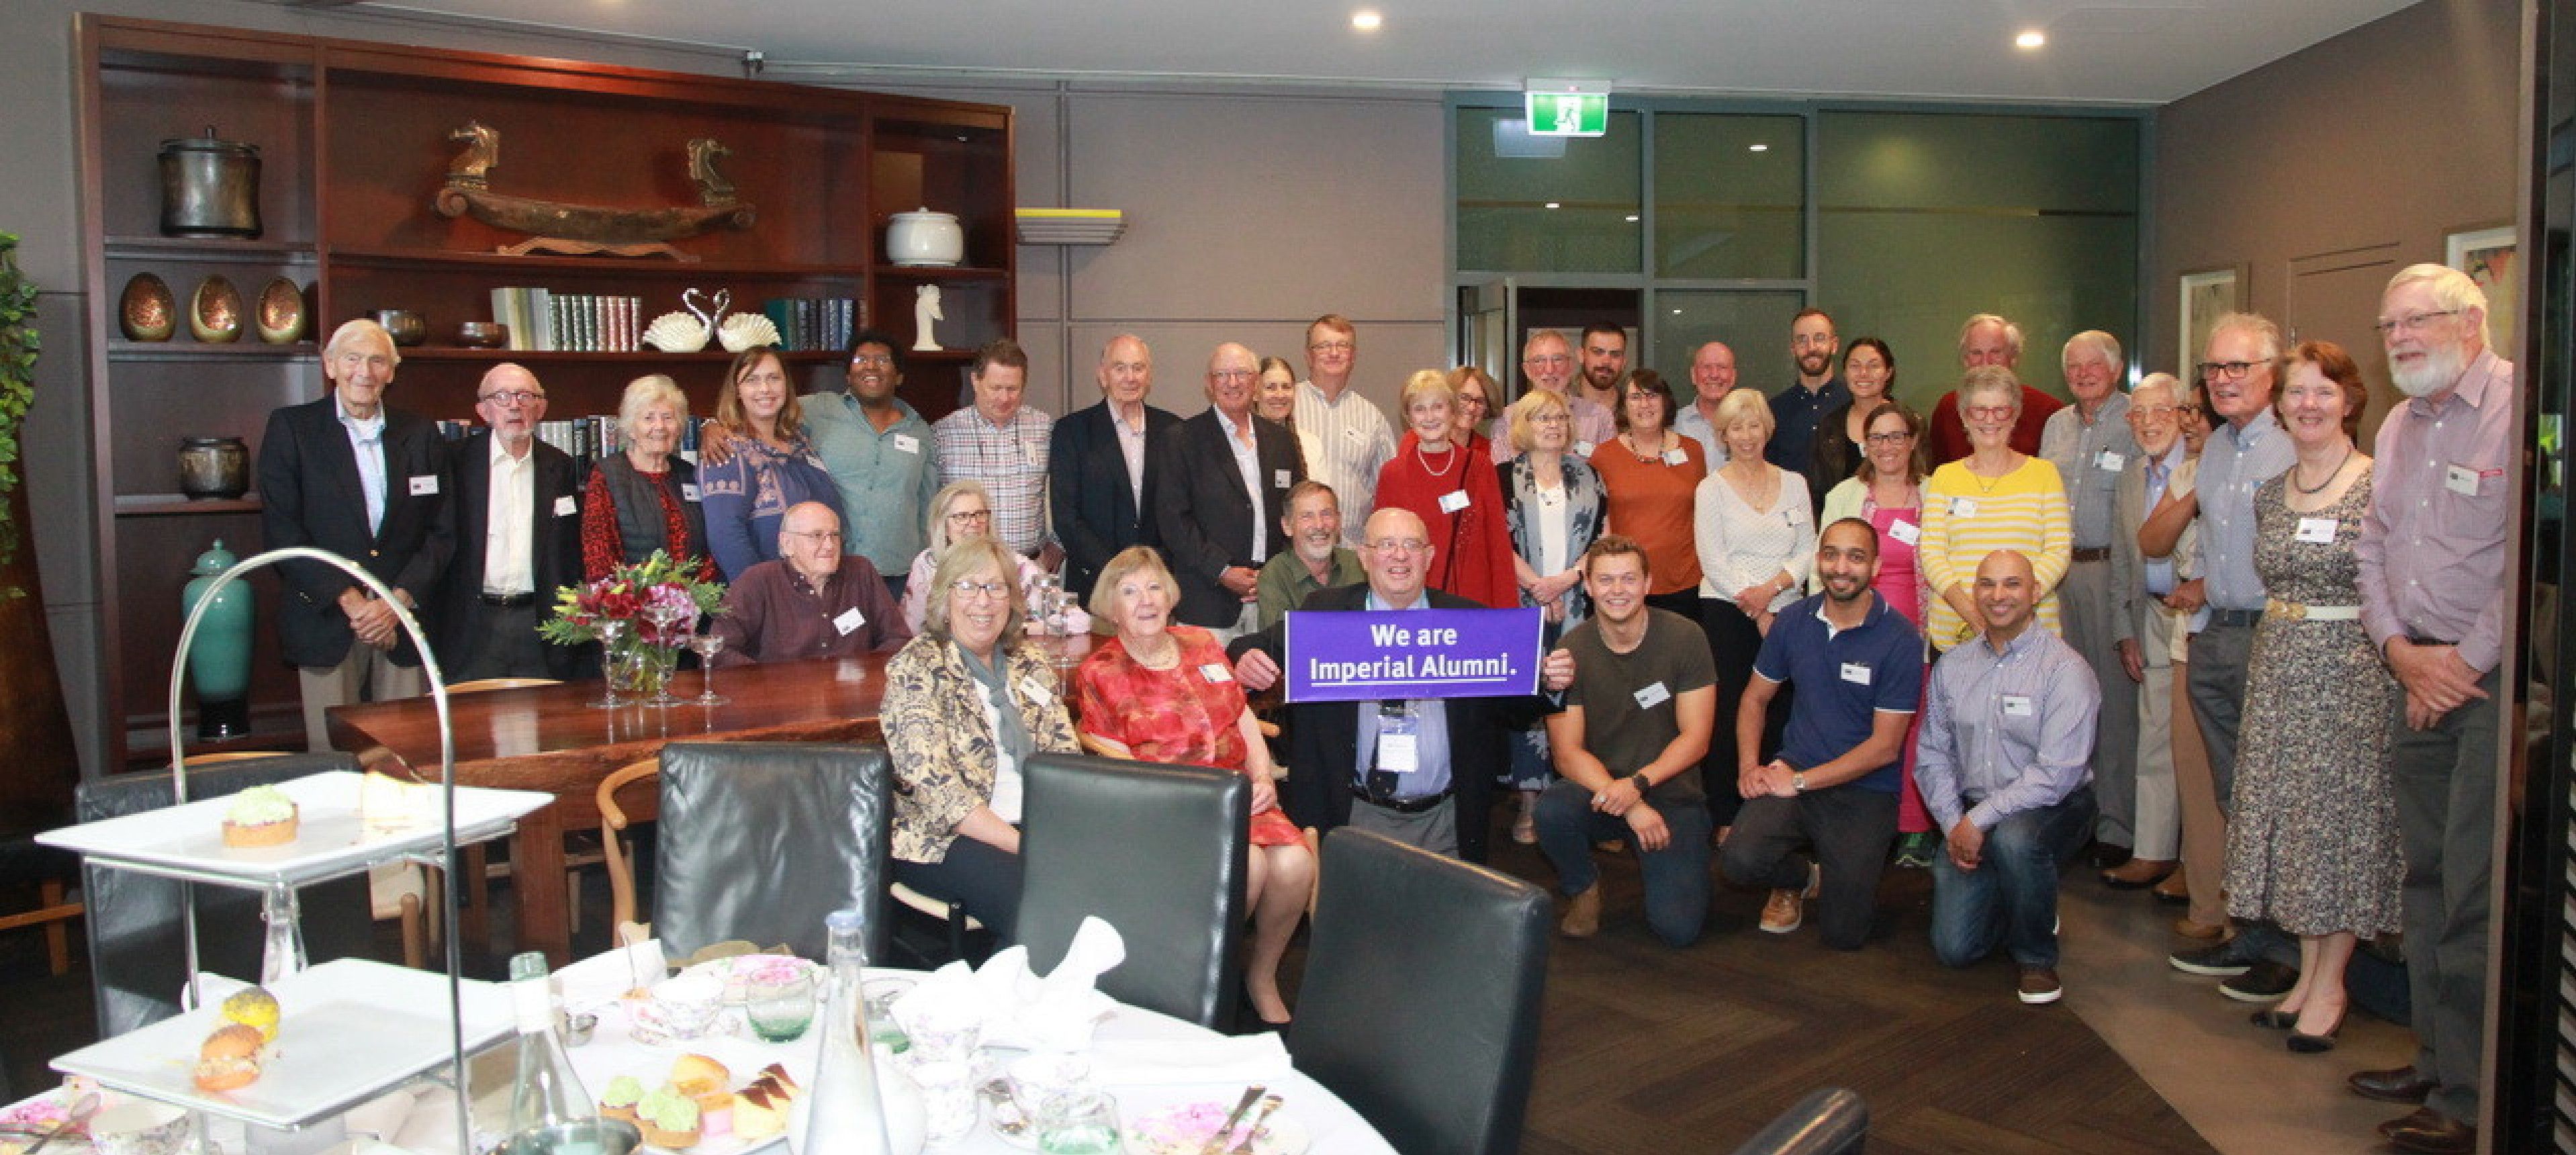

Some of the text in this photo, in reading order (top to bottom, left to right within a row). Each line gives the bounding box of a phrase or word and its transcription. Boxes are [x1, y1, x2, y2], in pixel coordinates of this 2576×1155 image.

[1371, 624, 1458, 647] We are
[1311, 652, 1518, 683] Imperial Alumni.
